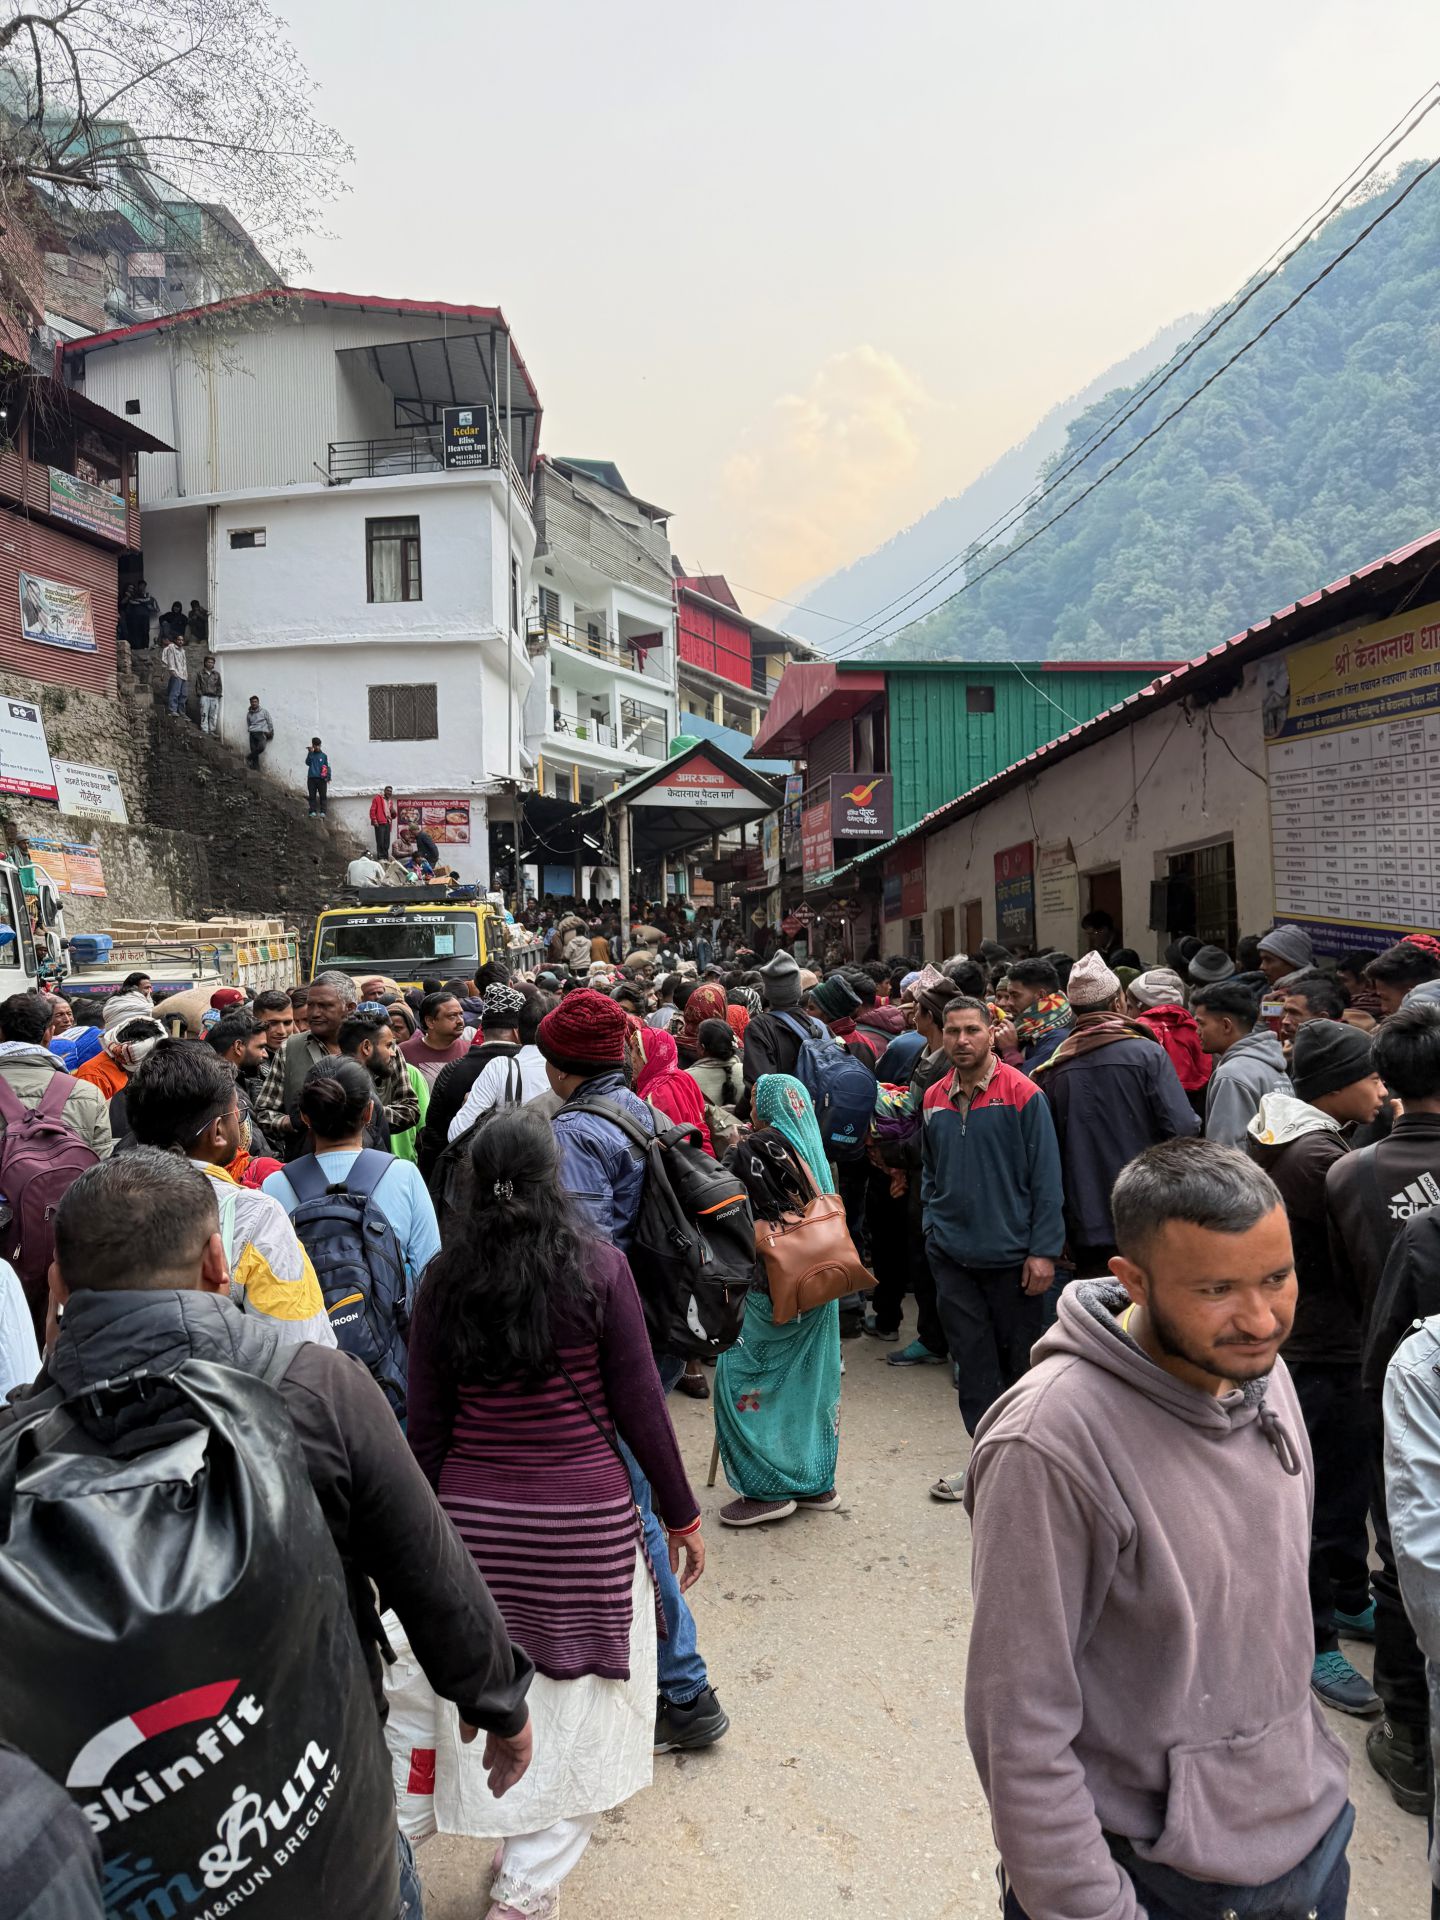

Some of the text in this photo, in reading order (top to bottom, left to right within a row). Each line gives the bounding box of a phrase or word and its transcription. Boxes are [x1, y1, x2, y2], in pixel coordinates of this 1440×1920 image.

[453, 426, 479, 436] Kedar
[1355, 631, 1414, 669] केदारनाथ
[667, 788, 734, 799] केदारनाथ पैदल मार्ग
[859, 807, 875, 817] पोस्ट
[864, 814, 878, 824] बैंक
[347, 917, 368, 925] जय
[413, 914, 446, 922] देवता
[1424, 1176, 1440, 1201] adidas
[82, 1693, 264, 1834] skinfit
[194, 1764, 341, 1920] M&RUN BREGENZ
